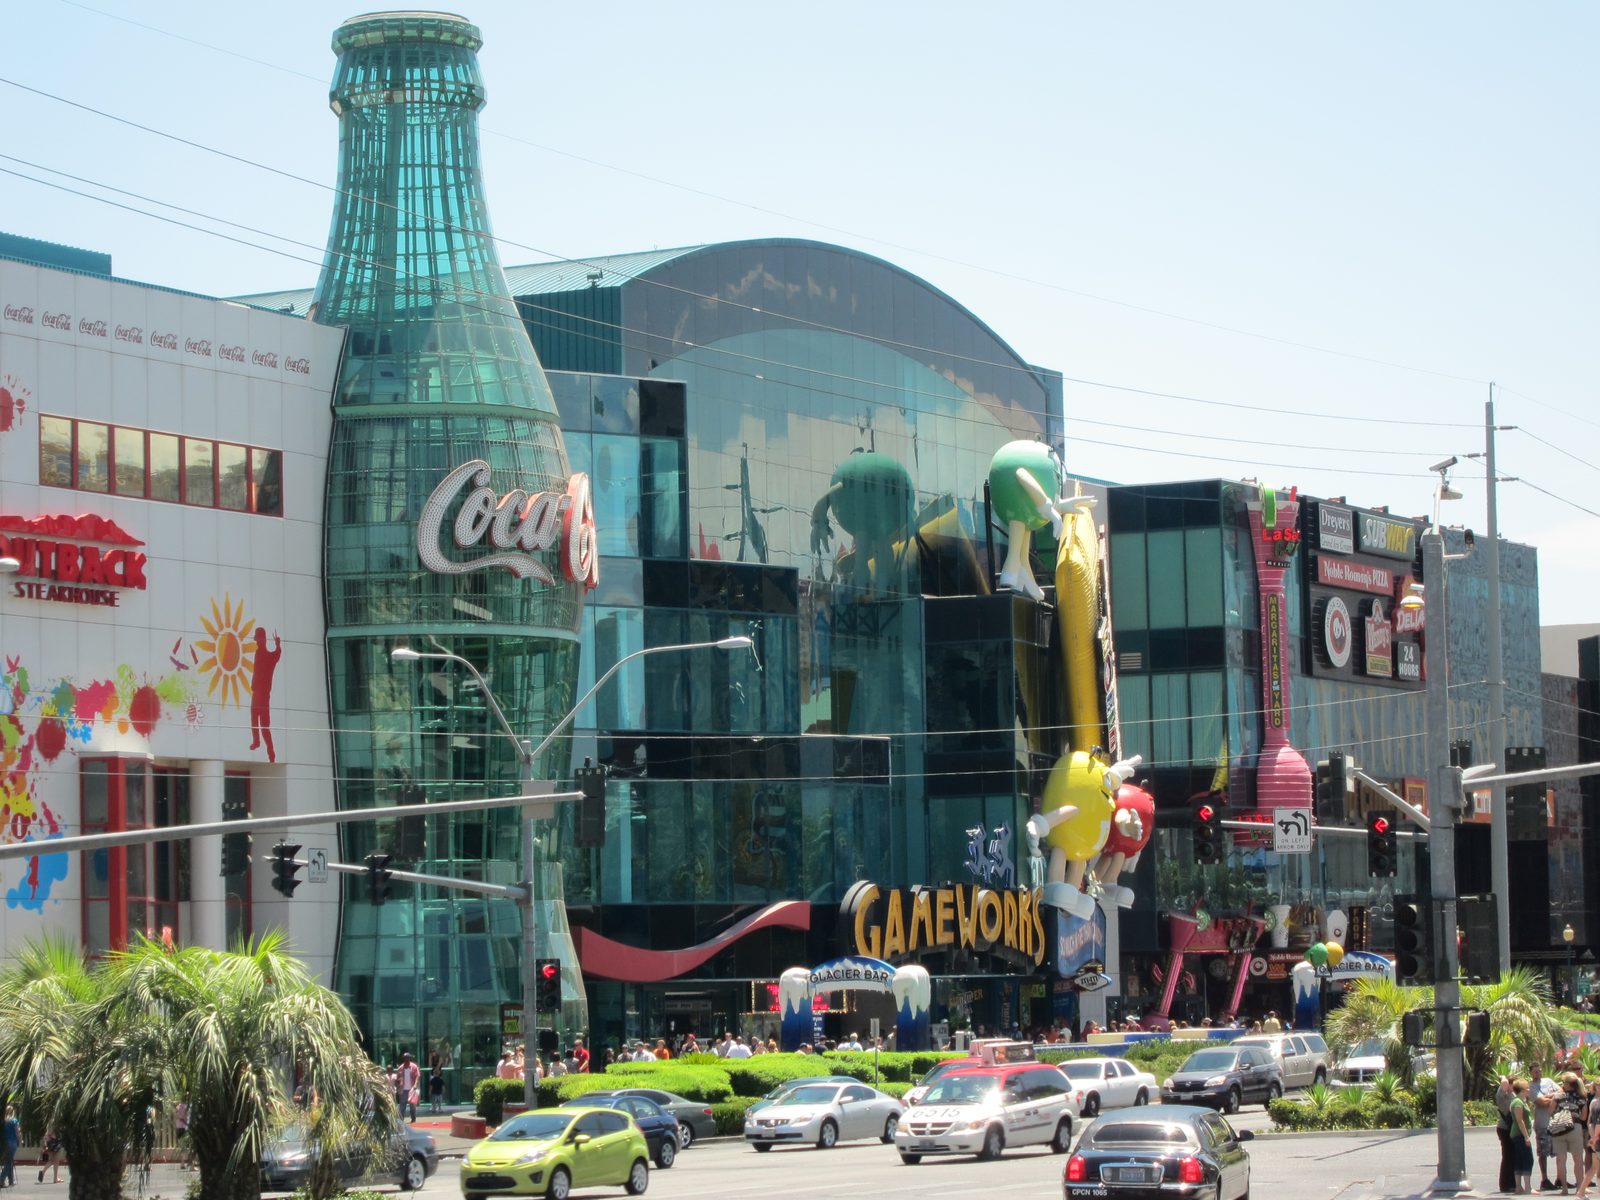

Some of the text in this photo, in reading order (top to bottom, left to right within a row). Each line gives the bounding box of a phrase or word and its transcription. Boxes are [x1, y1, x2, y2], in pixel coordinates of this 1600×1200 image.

[1363, 518, 1415, 553] SUBWAY
[1323, 560, 1344, 582] Noble
[1372, 569, 1389, 588] PIZZA
[14, 581, 120, 608] STEAKHOUSE
[1270, 596, 1279, 679] MARGARITAS
[1403, 646, 1414, 662] 24
[1399, 662, 1419, 677] HOURS
[1273, 692, 1281, 725] YARD
[854, 883, 1046, 967] GAMEWORKS
[809, 969, 889, 984] GLACIER BAR
[1319, 961, 1385, 973] GACIER BAR
[1072, 1188, 1091, 1196] CPCN
